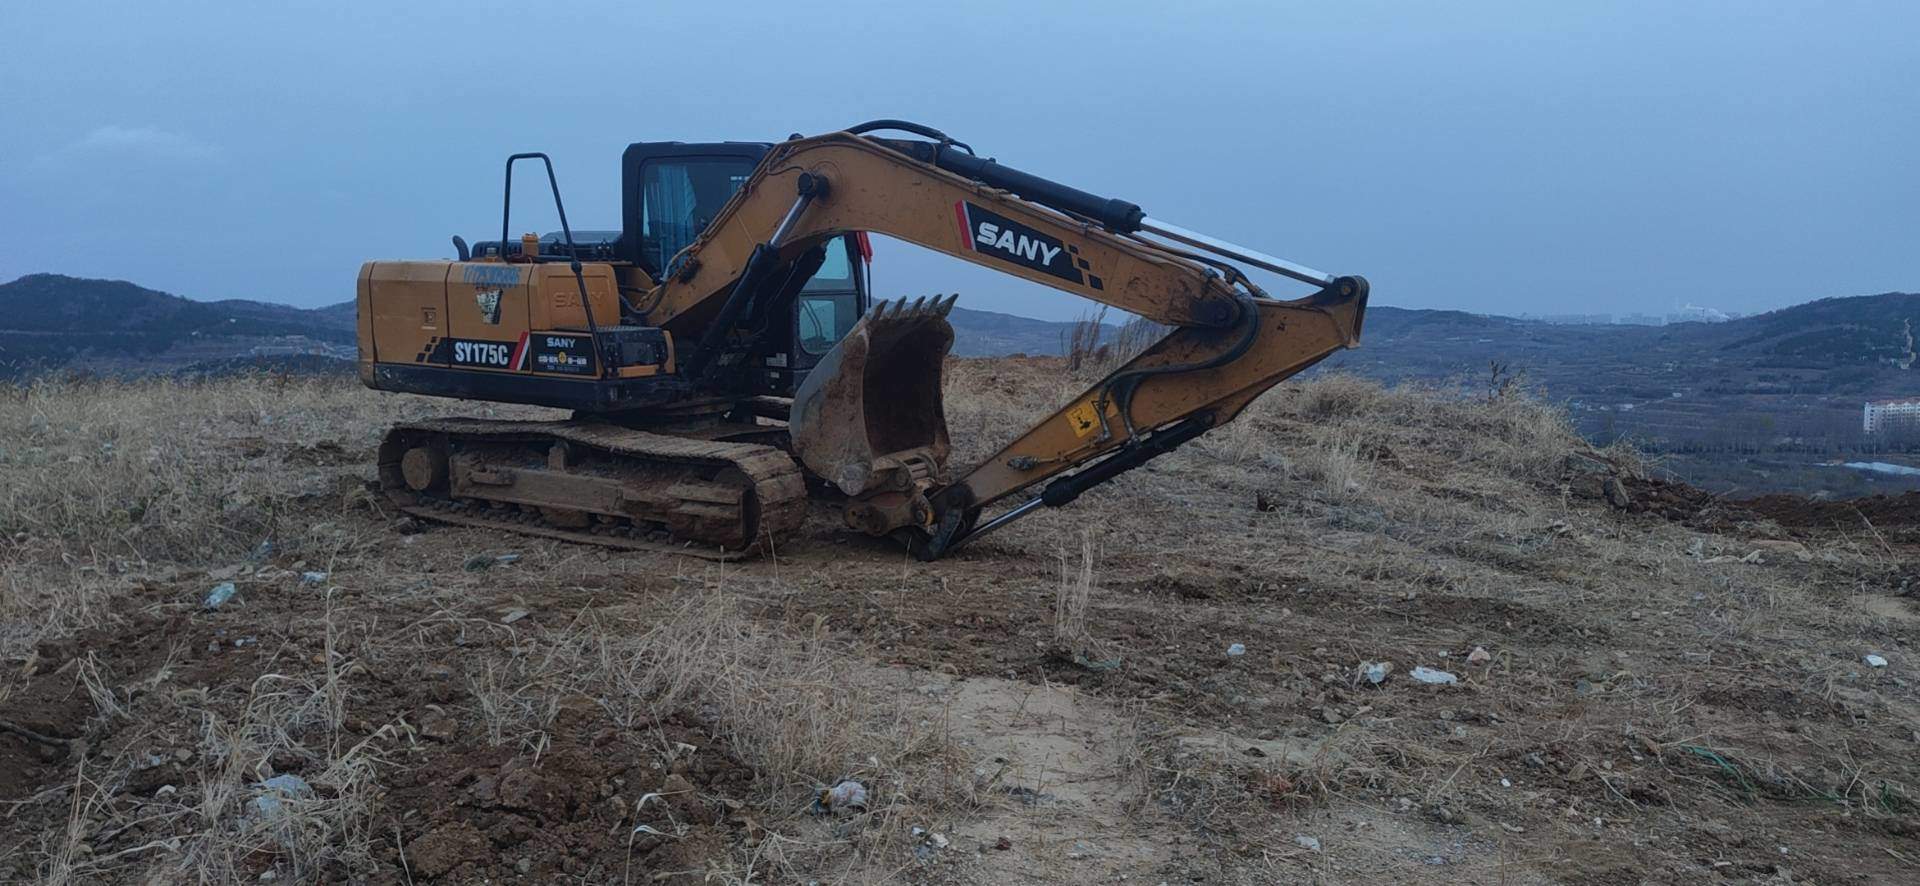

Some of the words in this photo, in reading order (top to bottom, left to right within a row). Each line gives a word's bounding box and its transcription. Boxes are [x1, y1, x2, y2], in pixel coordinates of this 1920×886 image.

[976, 221, 1062, 267] SANY
[553, 291, 608, 309] SAY
[454, 341, 509, 365] SY175C
[546, 337, 576, 349] SANY
